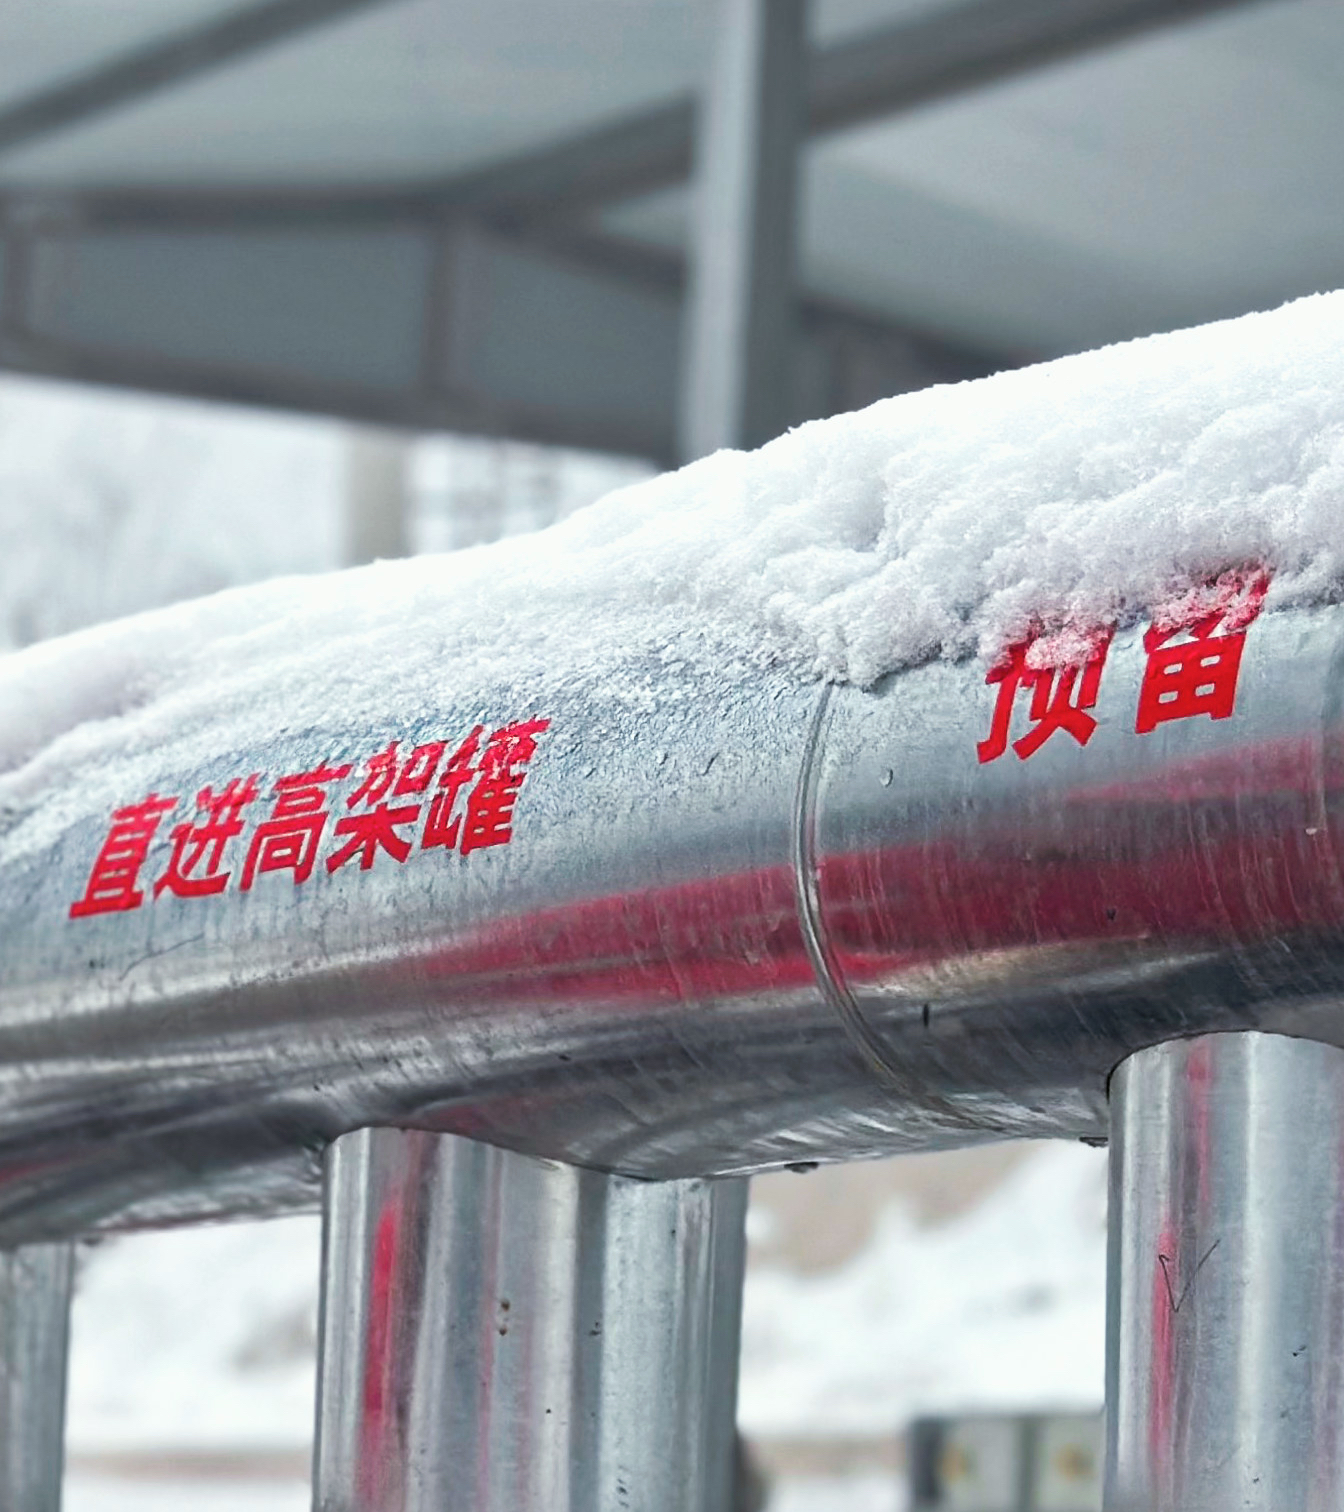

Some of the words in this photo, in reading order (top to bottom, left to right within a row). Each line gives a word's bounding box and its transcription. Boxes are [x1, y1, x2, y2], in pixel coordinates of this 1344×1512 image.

[68, 713, 552, 919] 直进高架罐
